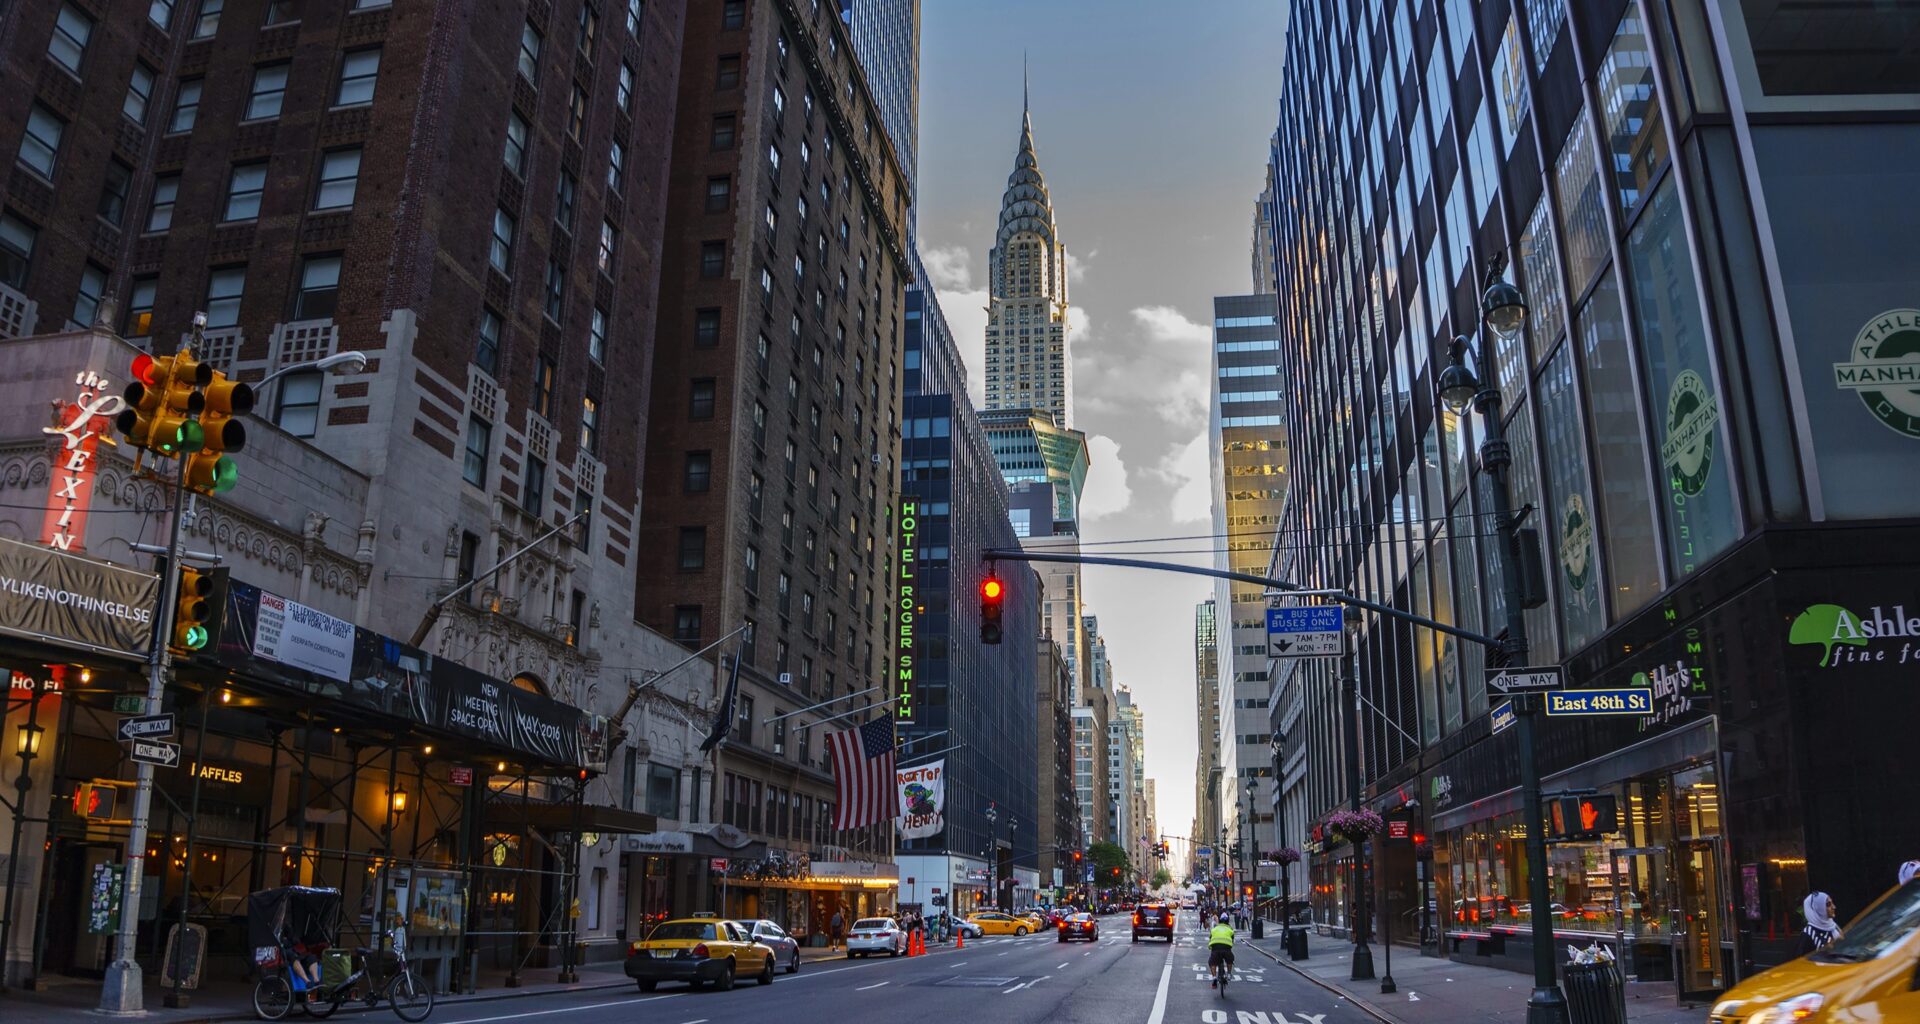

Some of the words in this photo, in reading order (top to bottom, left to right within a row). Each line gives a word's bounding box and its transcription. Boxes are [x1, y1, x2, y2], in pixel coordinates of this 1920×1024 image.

[76, 370, 109, 391] the
[1663, 399, 1717, 463] MANHATTAN
[901, 502, 915, 578] HOTEL
[0, 575, 151, 623] YLIKENOTHINGELSE
[262, 595, 285, 612] DANGER
[292, 613, 306, 624] NEW
[300, 606, 331, 624] LEXINGTON
[331, 617, 352, 634] AVENUE
[900, 586, 914, 648] ROGER
[1272, 618, 1306, 628] BUSES
[1311, 618, 1337, 626] ONLY
[1291, 610, 1308, 618] BUS
[1312, 609, 1335, 617] LANE
[1831, 605, 1920, 639] Ashle
[1297, 644, 1314, 652] MON
[1323, 643, 1337, 651] FRI
[1831, 646, 1885, 668] fine
[481, 682, 499, 698] NEW
[899, 655, 913, 717] SMITH
[1497, 676, 1519, 687] ONE
[1529, 674, 1553, 685] WAY
[465, 695, 498, 717] MEETING
[1553, 694, 1587, 711] East
[1590, 693, 1625, 711] 48th
[1628, 693, 1646, 710] St
[126, 723, 142, 734] ONE
[149, 721, 167, 731] WAY
[450, 708, 476, 728] SPACE
[541, 723, 561, 741] 2016
[139, 745, 153, 756] ONE
[158, 749, 173, 759] WAY
[902, 810, 944, 830] HENRY
[1201, 1009, 1327, 1024] ONLY
